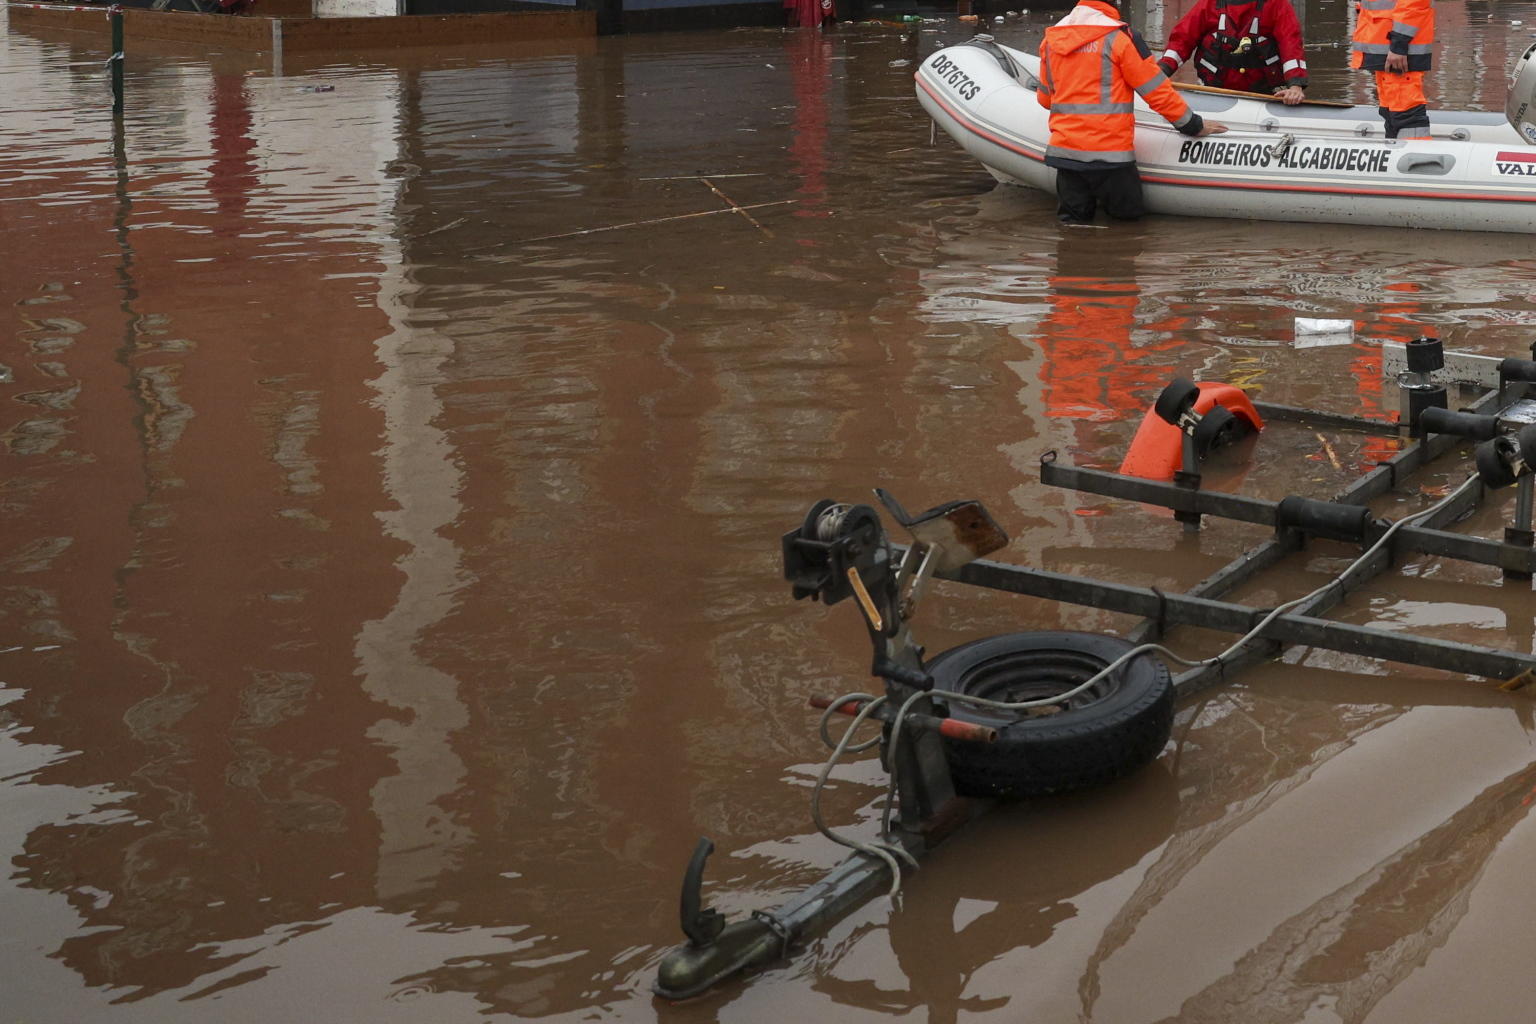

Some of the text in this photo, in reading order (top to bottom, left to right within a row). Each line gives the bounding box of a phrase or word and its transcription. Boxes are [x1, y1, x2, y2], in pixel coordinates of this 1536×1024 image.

[930, 54, 981, 101] D8767CS
[1178, 140, 1391, 173] BOMBEIROS ALCABIDECHE
